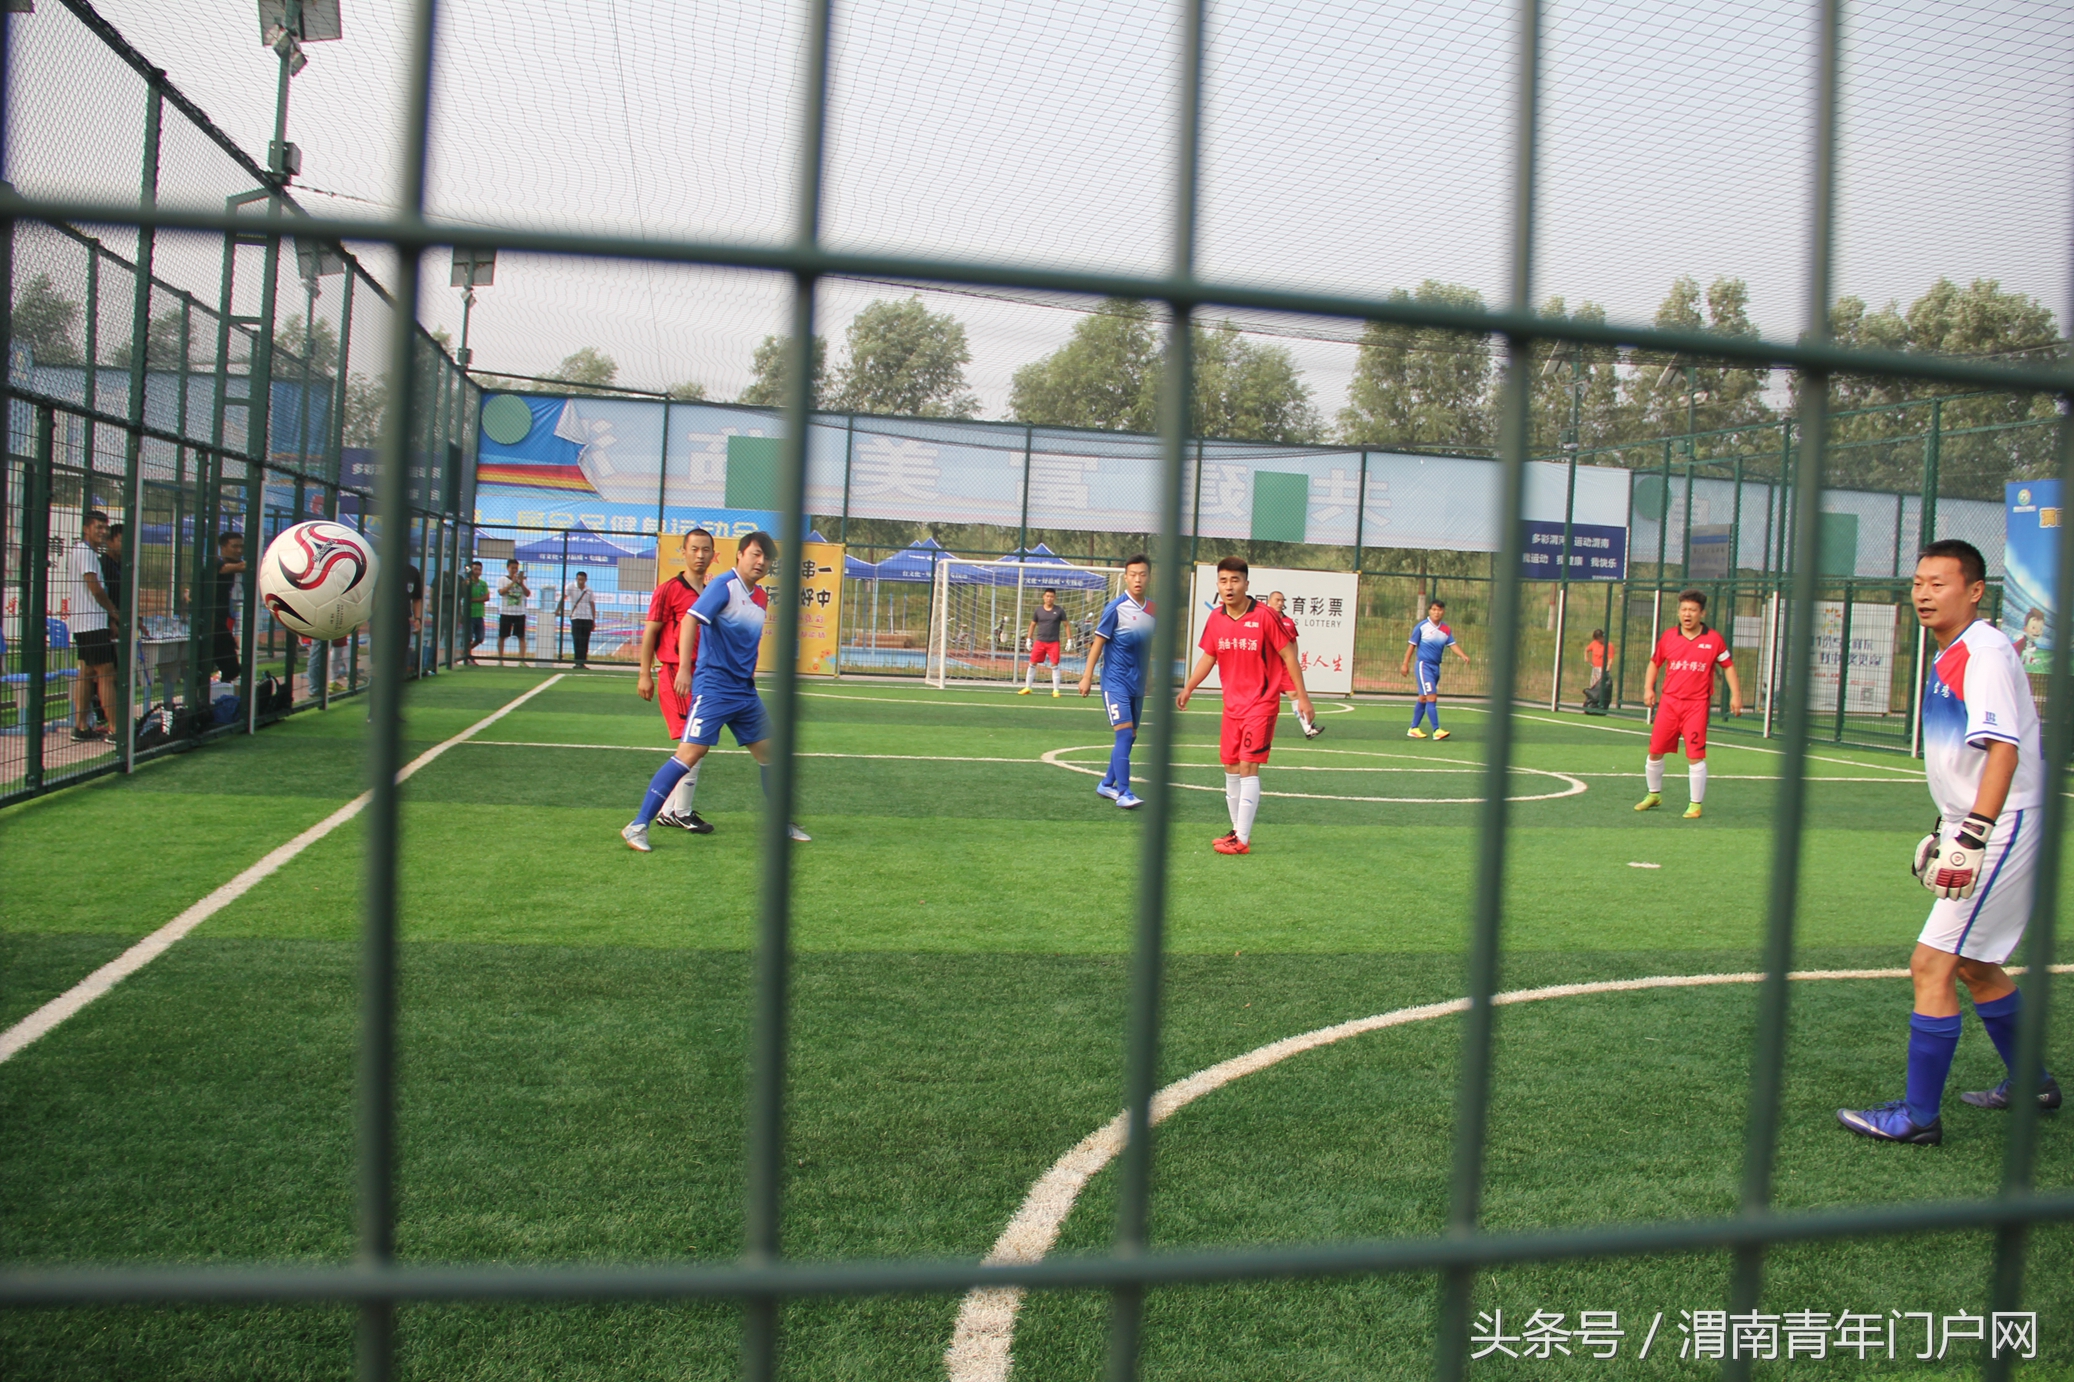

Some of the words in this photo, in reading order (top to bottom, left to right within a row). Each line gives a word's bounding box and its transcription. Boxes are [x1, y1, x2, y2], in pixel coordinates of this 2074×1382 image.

[1304, 618, 1342, 629] LOTTERY
[1425, 682, 1432, 692] 3
[1110, 704, 1120, 720] 5
[689, 718, 703, 738] 6
[1243, 731, 1252, 748] 6
[1690, 731, 1699, 744] 2
